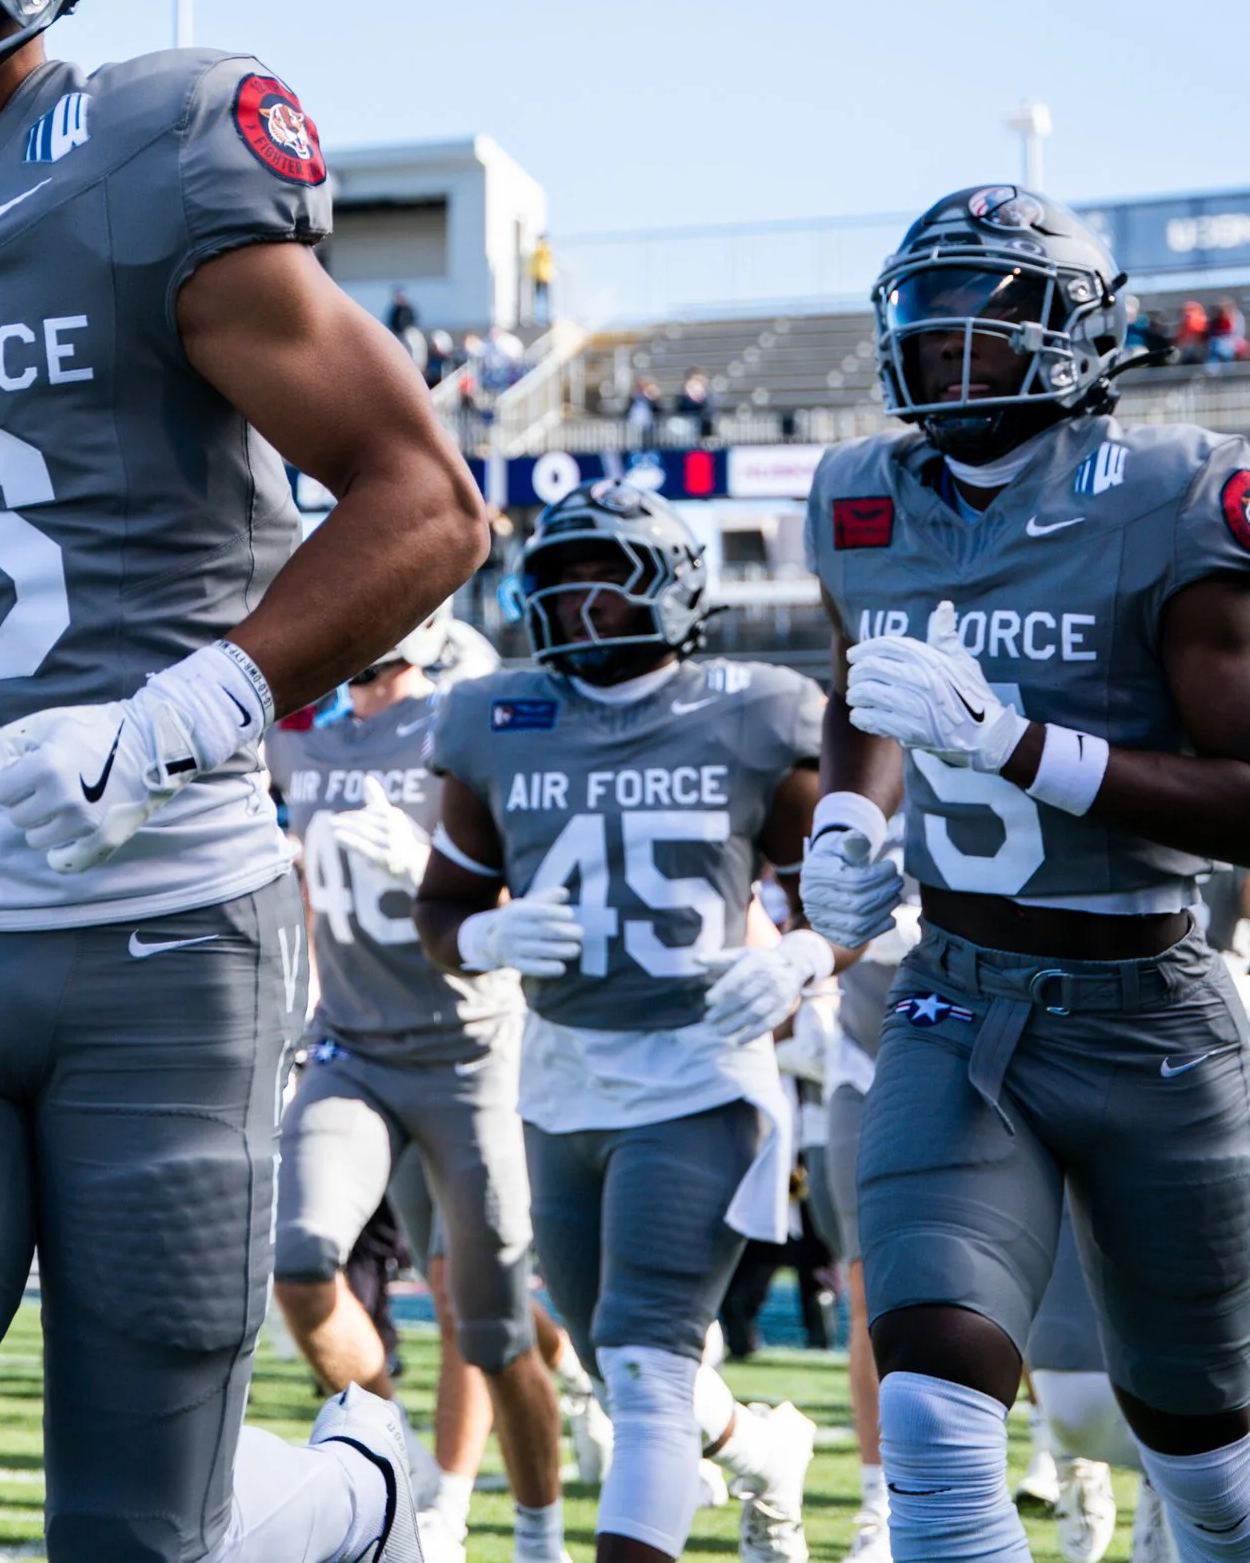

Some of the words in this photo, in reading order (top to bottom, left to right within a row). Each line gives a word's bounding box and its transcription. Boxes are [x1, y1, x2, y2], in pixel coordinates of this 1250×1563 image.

[506, 771, 569, 812] AIR
[586, 764, 728, 809] FORCE
[910, 683, 1046, 896] 5
[524, 810, 731, 978] 45
